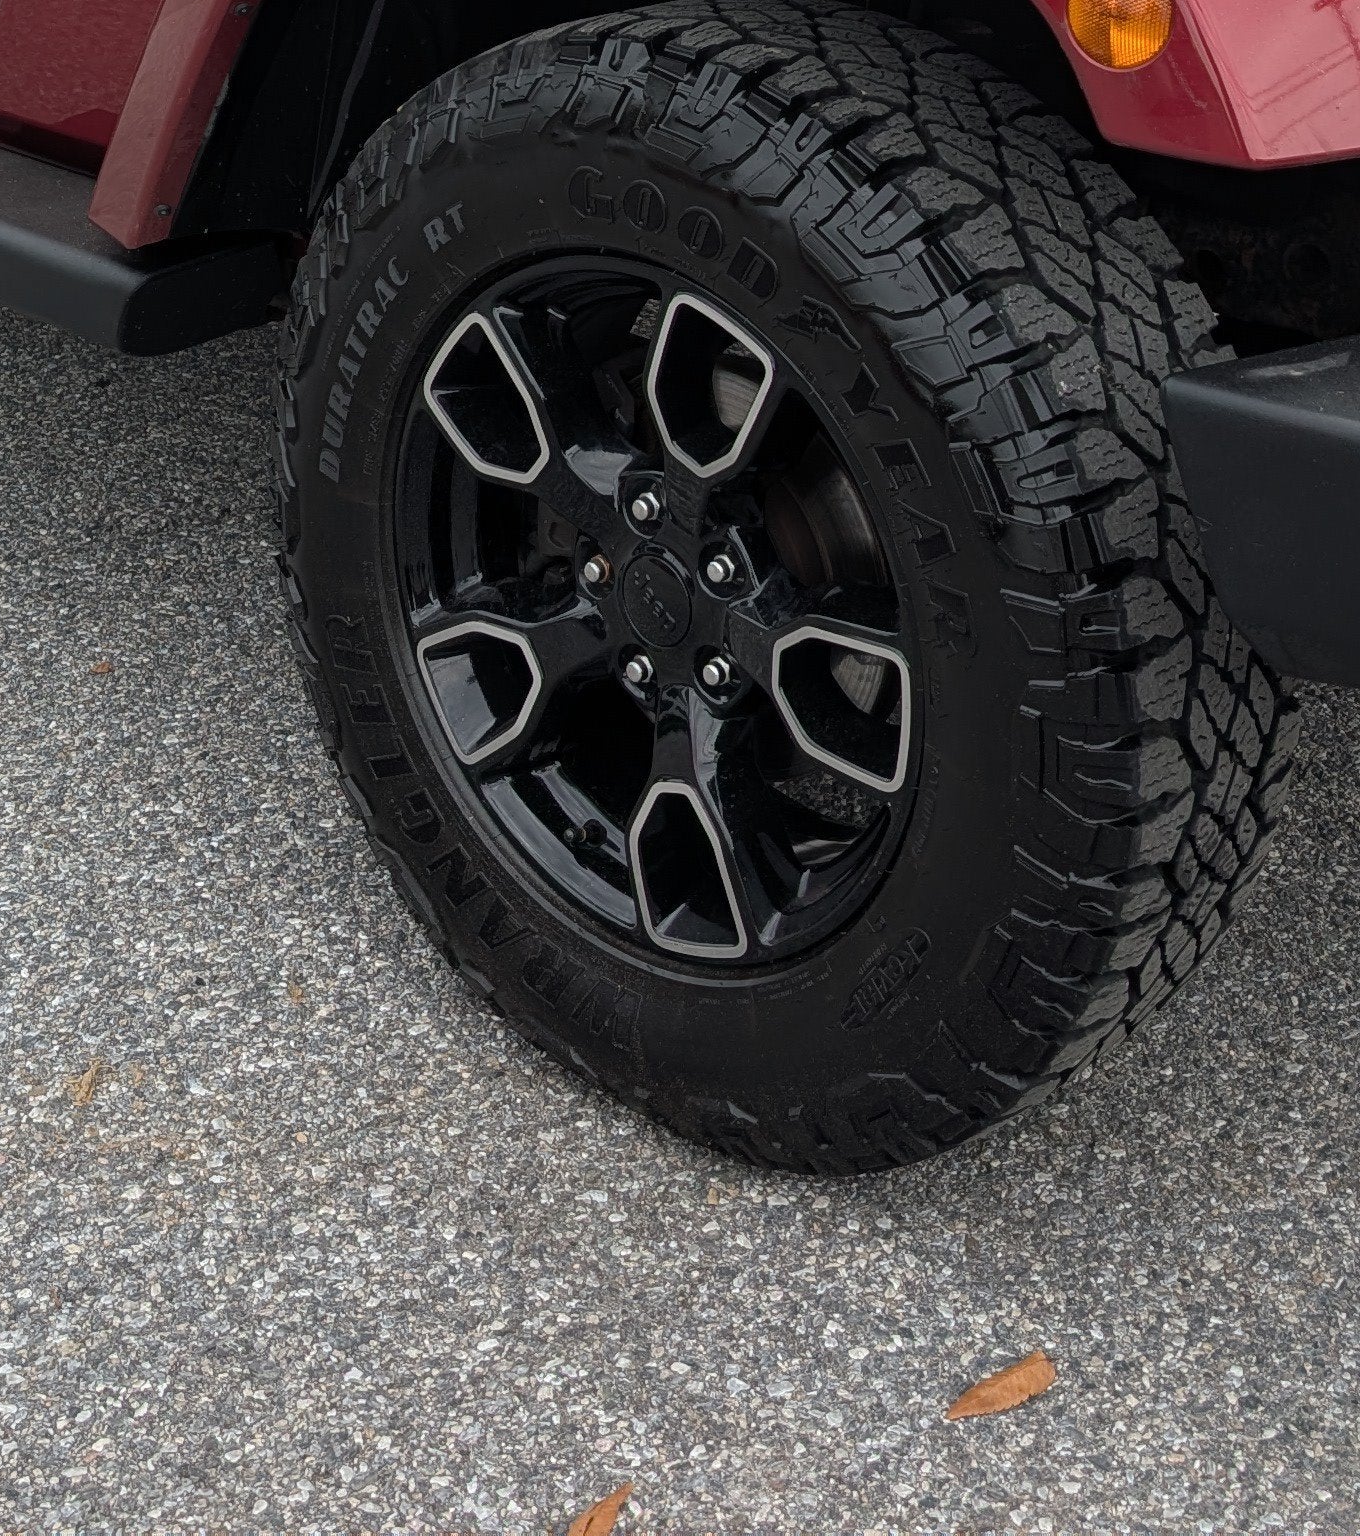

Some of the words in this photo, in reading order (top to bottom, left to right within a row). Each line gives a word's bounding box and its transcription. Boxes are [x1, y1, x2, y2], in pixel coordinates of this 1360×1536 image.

[318, 255, 411, 483] DURATRAC
[423, 201, 467, 255] RT
[323, 614, 644, 1051] WRANGLER
